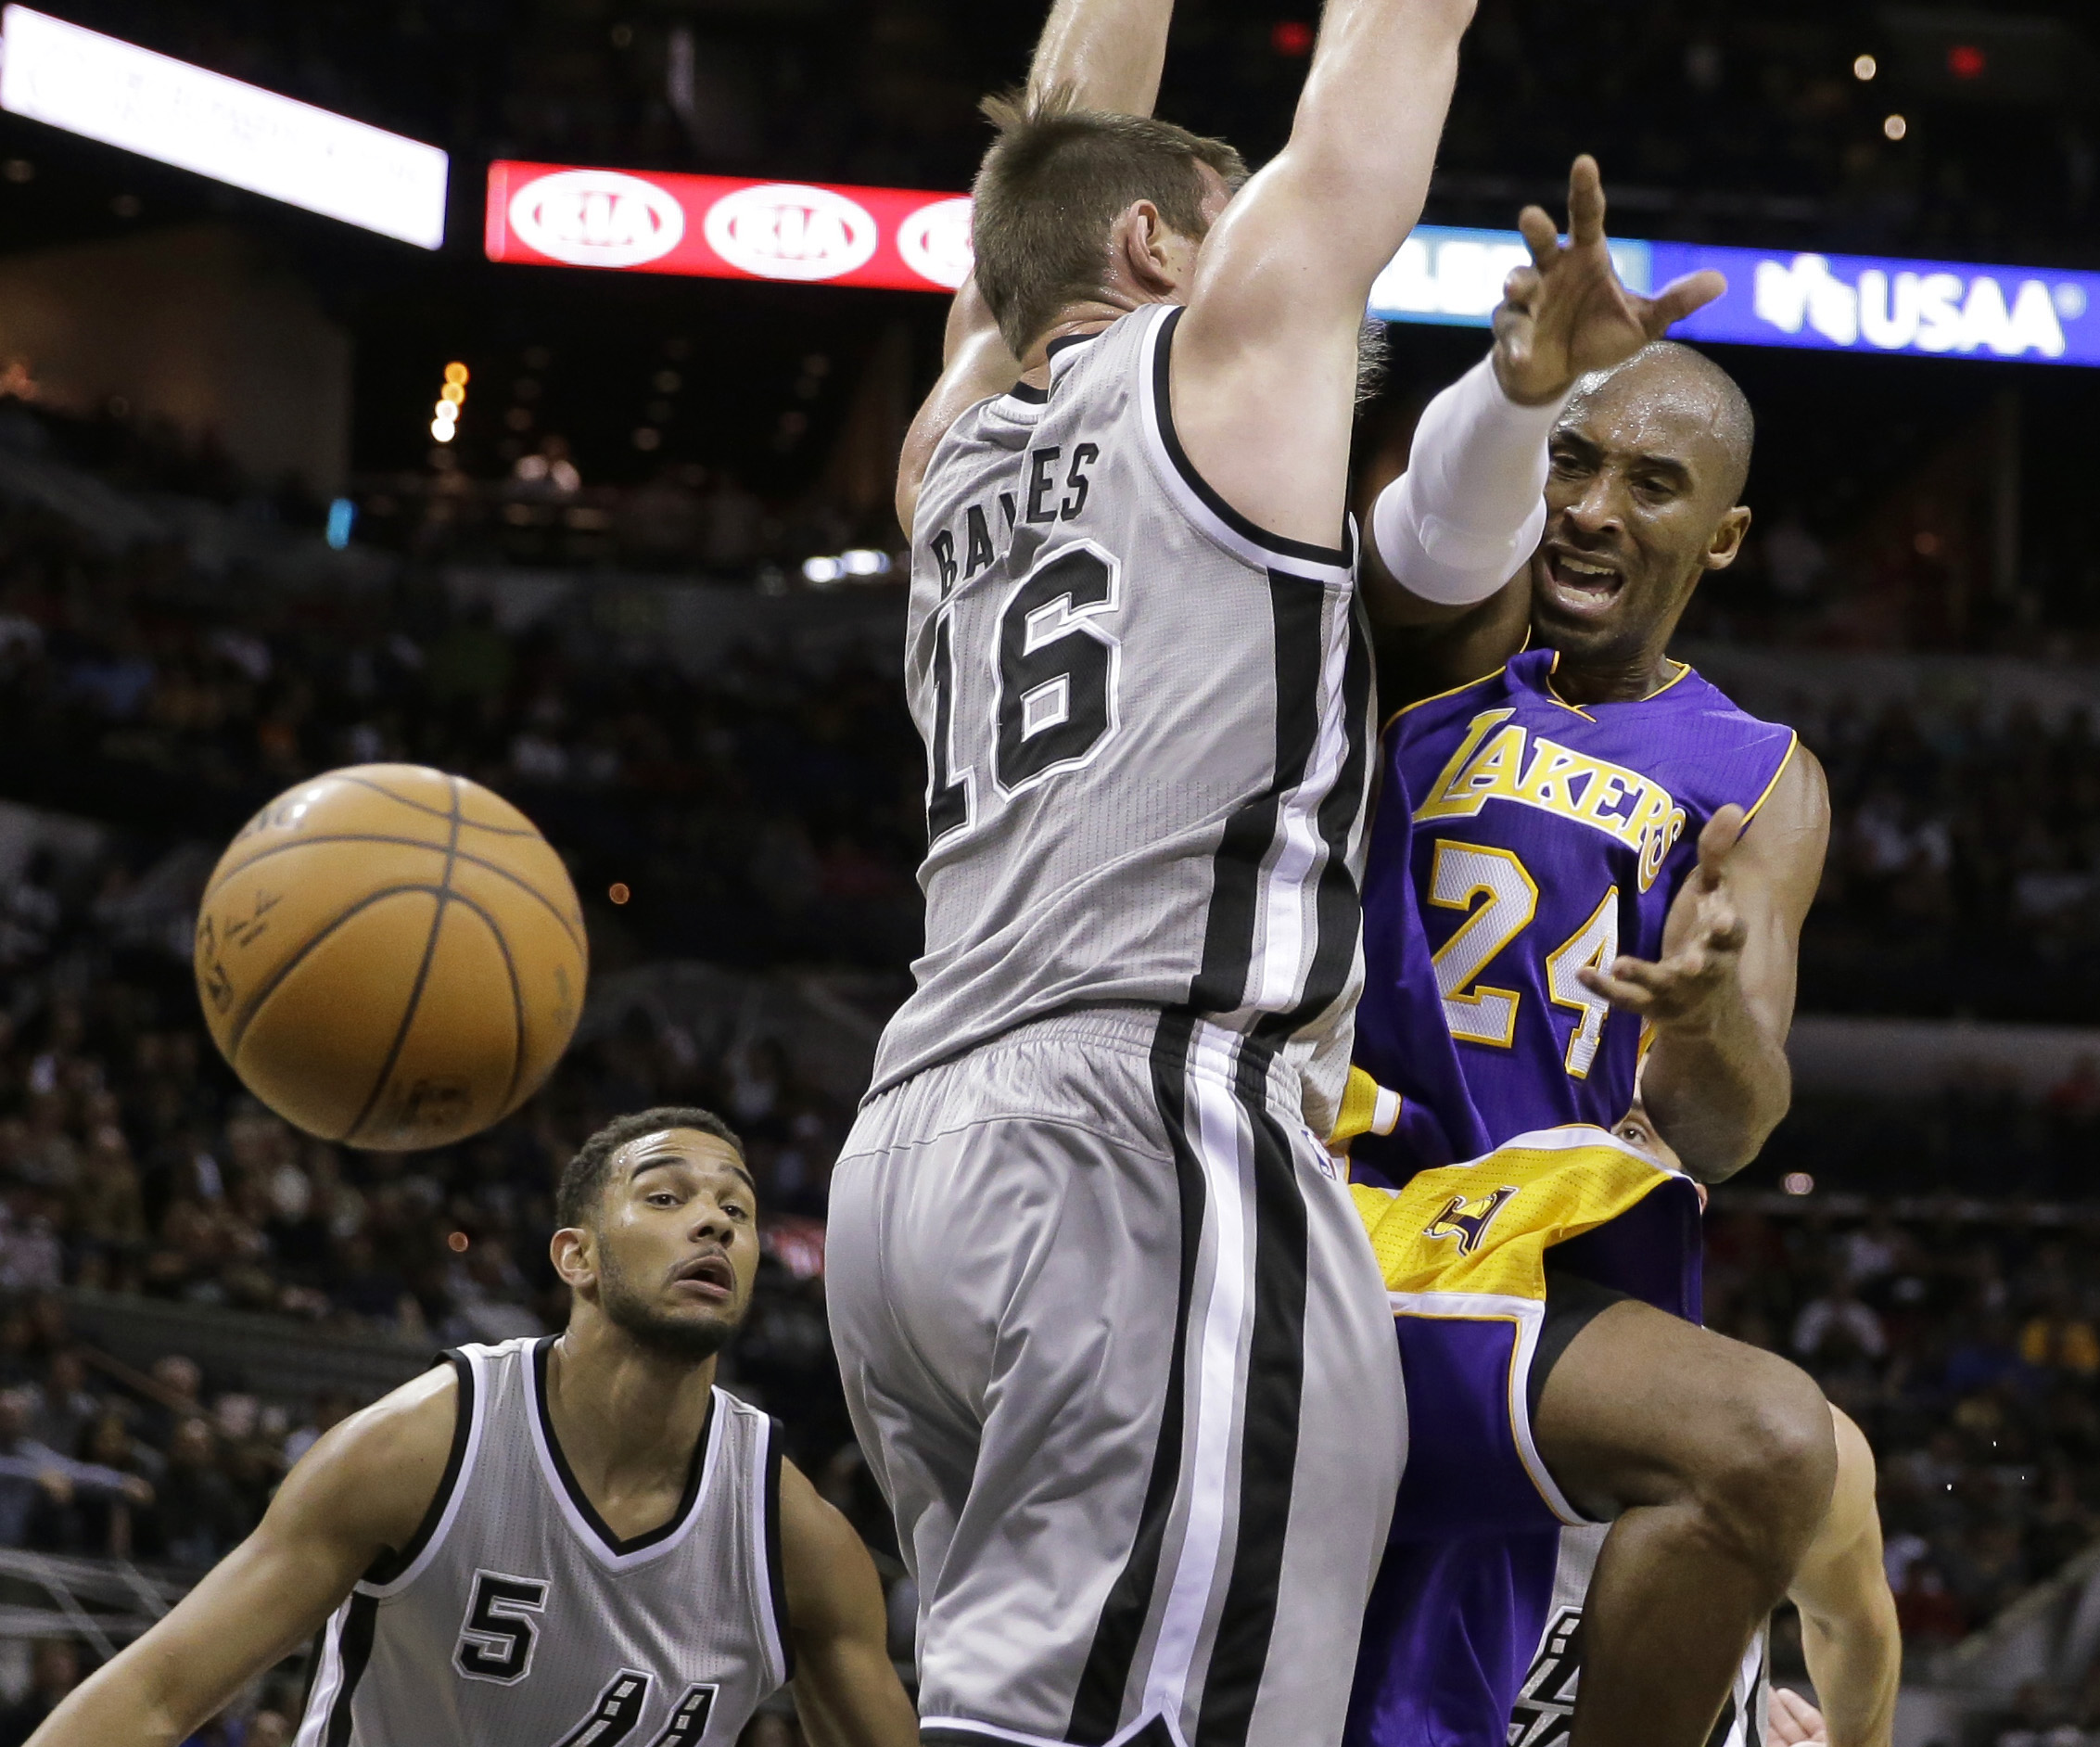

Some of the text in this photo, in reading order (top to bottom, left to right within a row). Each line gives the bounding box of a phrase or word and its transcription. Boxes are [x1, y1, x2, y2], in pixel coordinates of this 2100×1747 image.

[1858, 269, 2066, 358] USAA
[927, 538, 1122, 849] 16
[1412, 708, 1686, 893] LAKERS
[1427, 838, 1620, 1079] 24
[452, 1568, 552, 1687] 5
